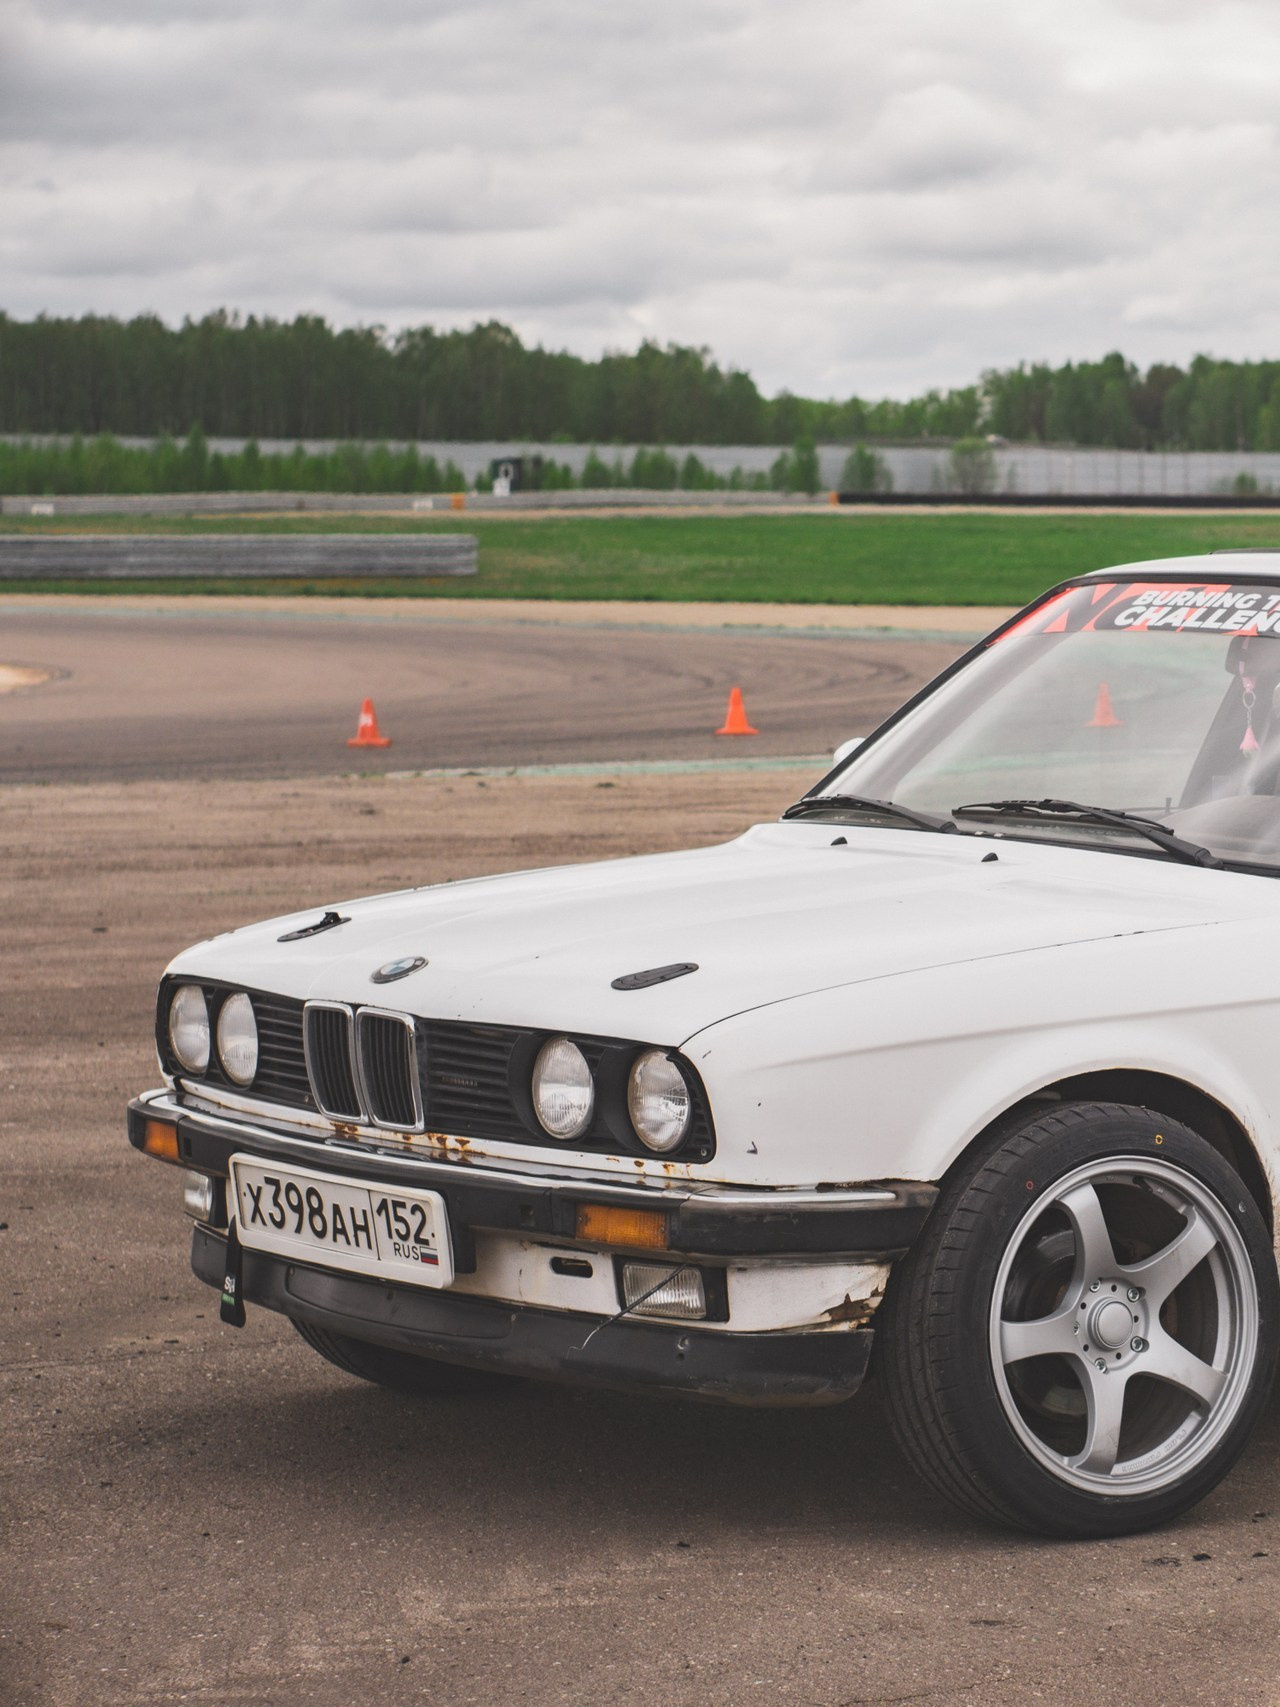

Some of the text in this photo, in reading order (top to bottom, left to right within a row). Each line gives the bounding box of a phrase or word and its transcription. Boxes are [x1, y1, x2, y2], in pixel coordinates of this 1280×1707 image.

[1131, 590, 1257, 610] BURNING
[247, 1176, 430, 1250] X398AH 152
[394, 1242, 420, 1261] RUS
